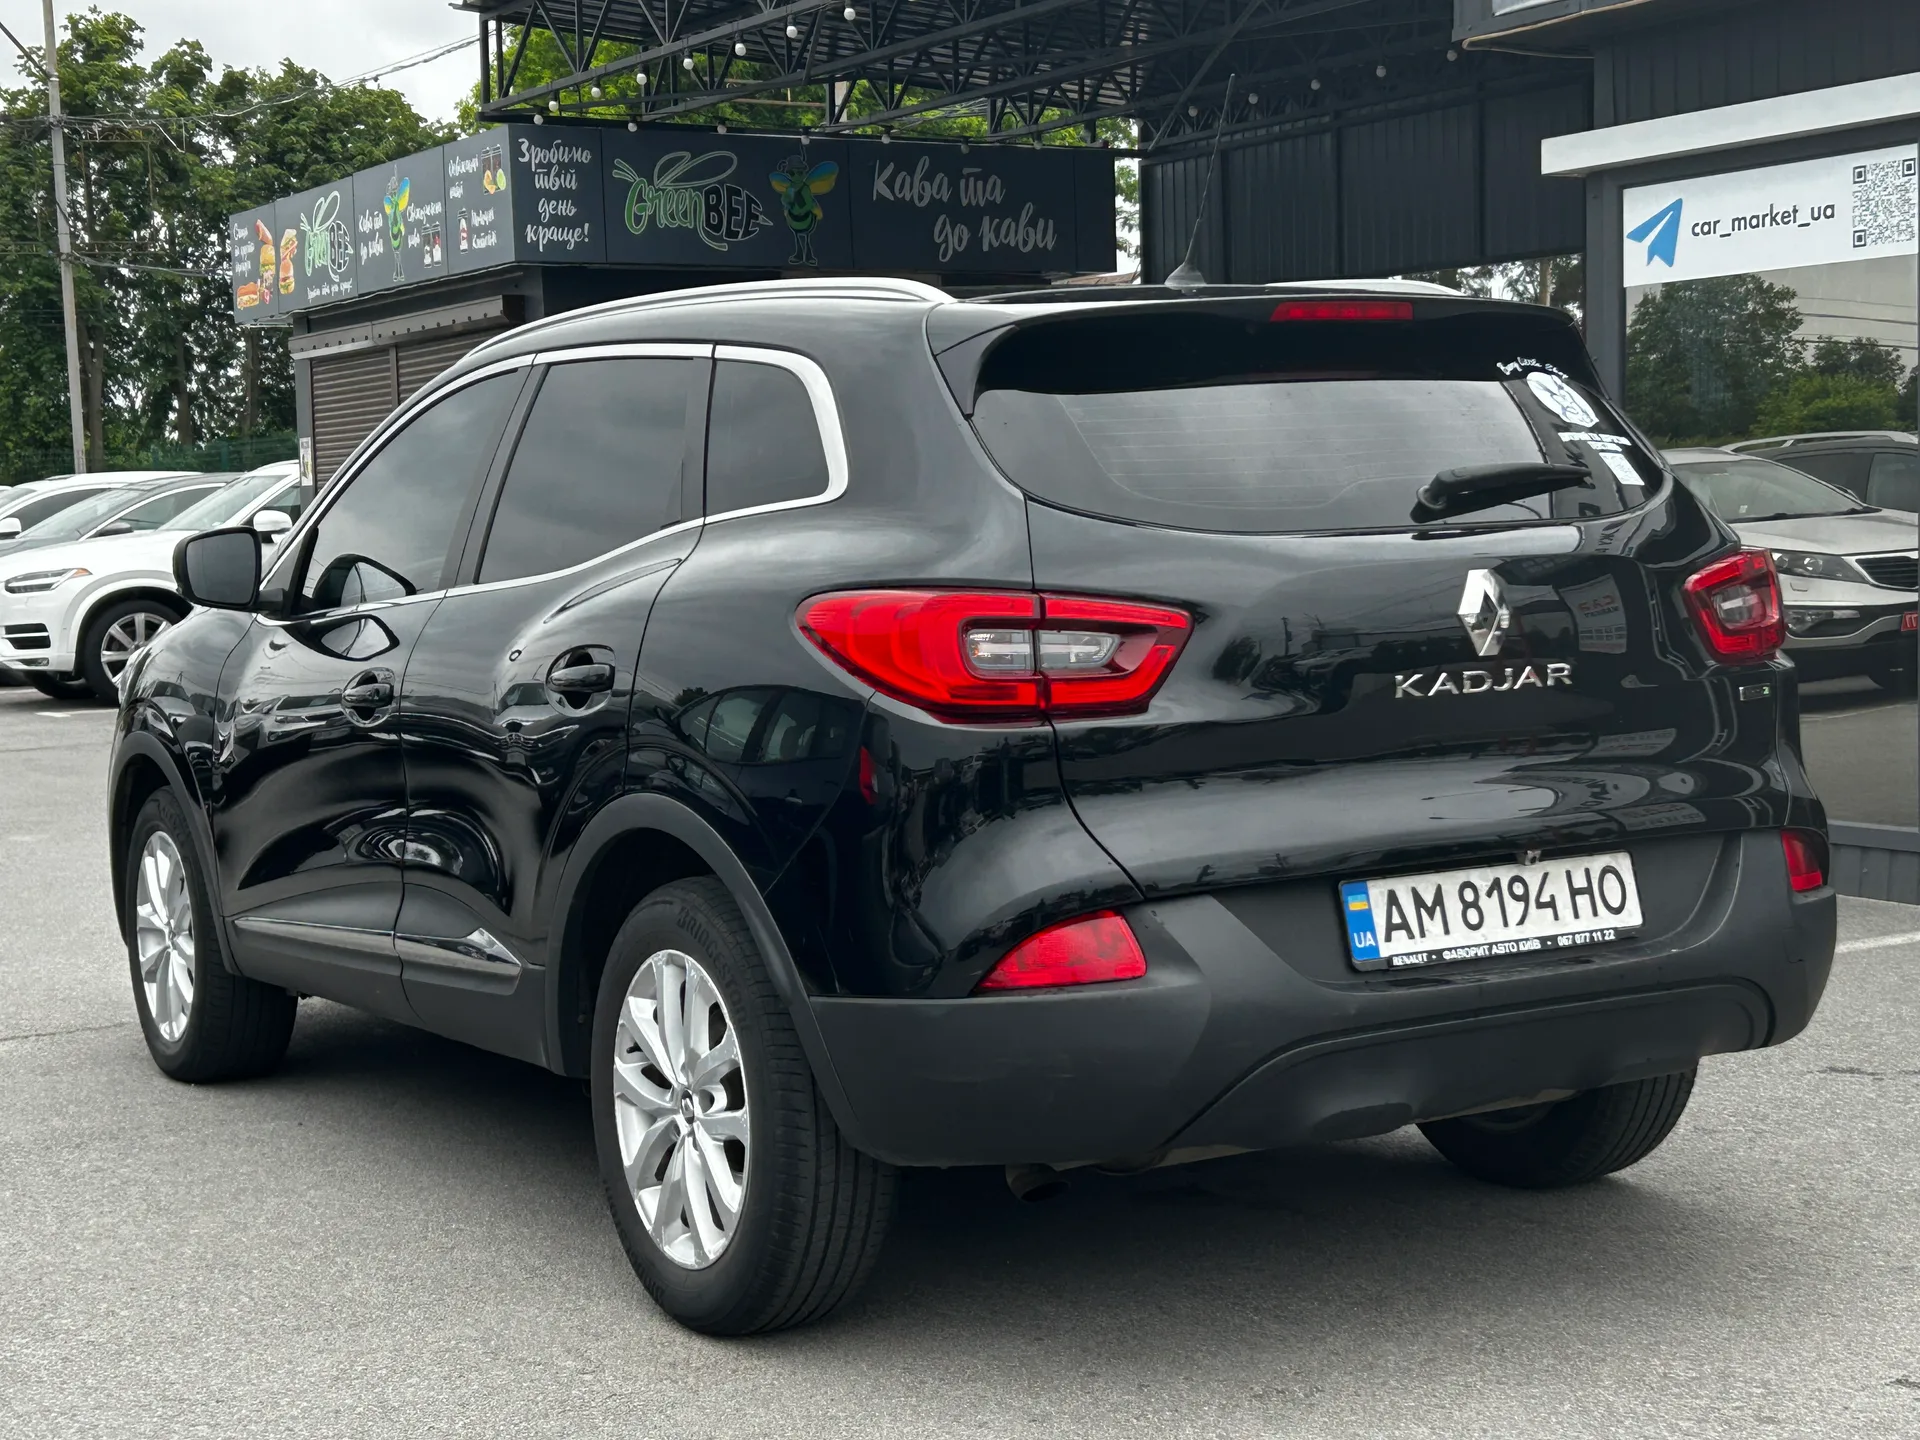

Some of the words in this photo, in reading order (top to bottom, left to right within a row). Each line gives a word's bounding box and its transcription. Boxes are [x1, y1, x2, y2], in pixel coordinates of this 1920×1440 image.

[518, 138, 592, 171] Зробимо
[534, 167, 578, 191] твій
[872, 155, 952, 208] Кава
[959, 167, 1006, 207] та
[537, 197, 578, 223] день
[1691, 203, 1836, 238] car_market_ua
[524, 222, 590, 252] краще!
[933, 212, 970, 263] до
[978, 202, 1057, 253] кави
[1394, 662, 1573, 699] KADJAR
[1384, 884, 1450, 943] AM
[1457, 871, 1559, 931] 8194
[1565, 865, 1627, 920] HO
[1354, 932, 1376, 949] UA
